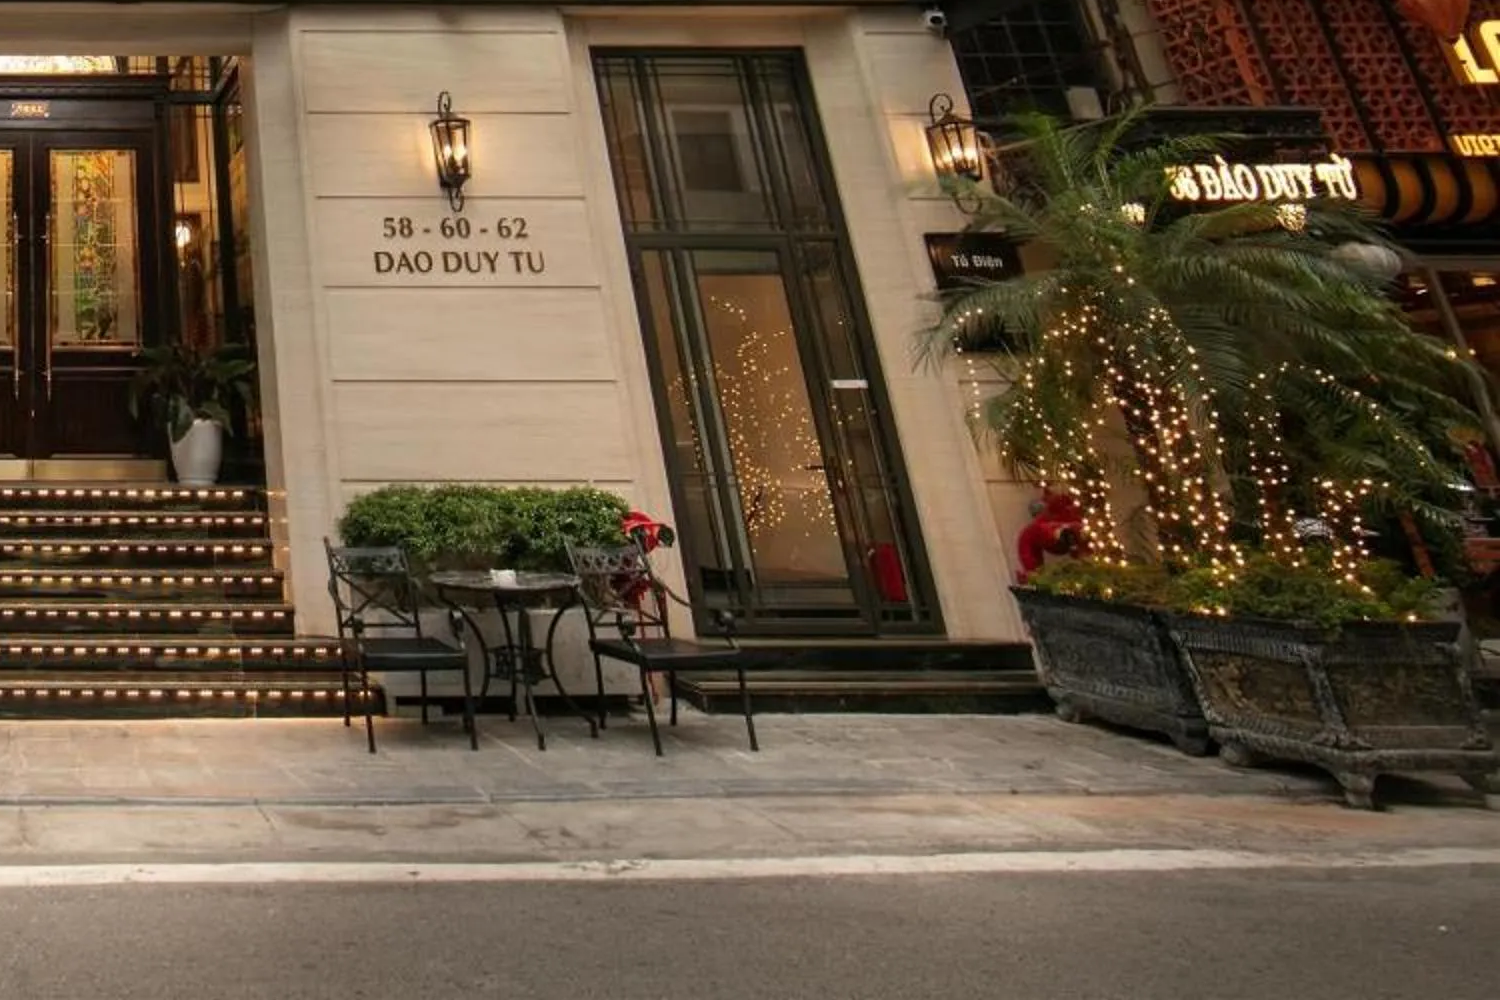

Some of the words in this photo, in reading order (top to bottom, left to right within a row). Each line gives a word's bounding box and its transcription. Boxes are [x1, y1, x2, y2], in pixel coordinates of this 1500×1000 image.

[1256, 163, 1316, 199] DUY
[383, 217, 414, 238] 58
[440, 217, 471, 238] 60
[497, 217, 529, 238] 62
[374, 251, 433, 273] DAO
[442, 251, 499, 273] DUY
[509, 251, 545, 273] TU
